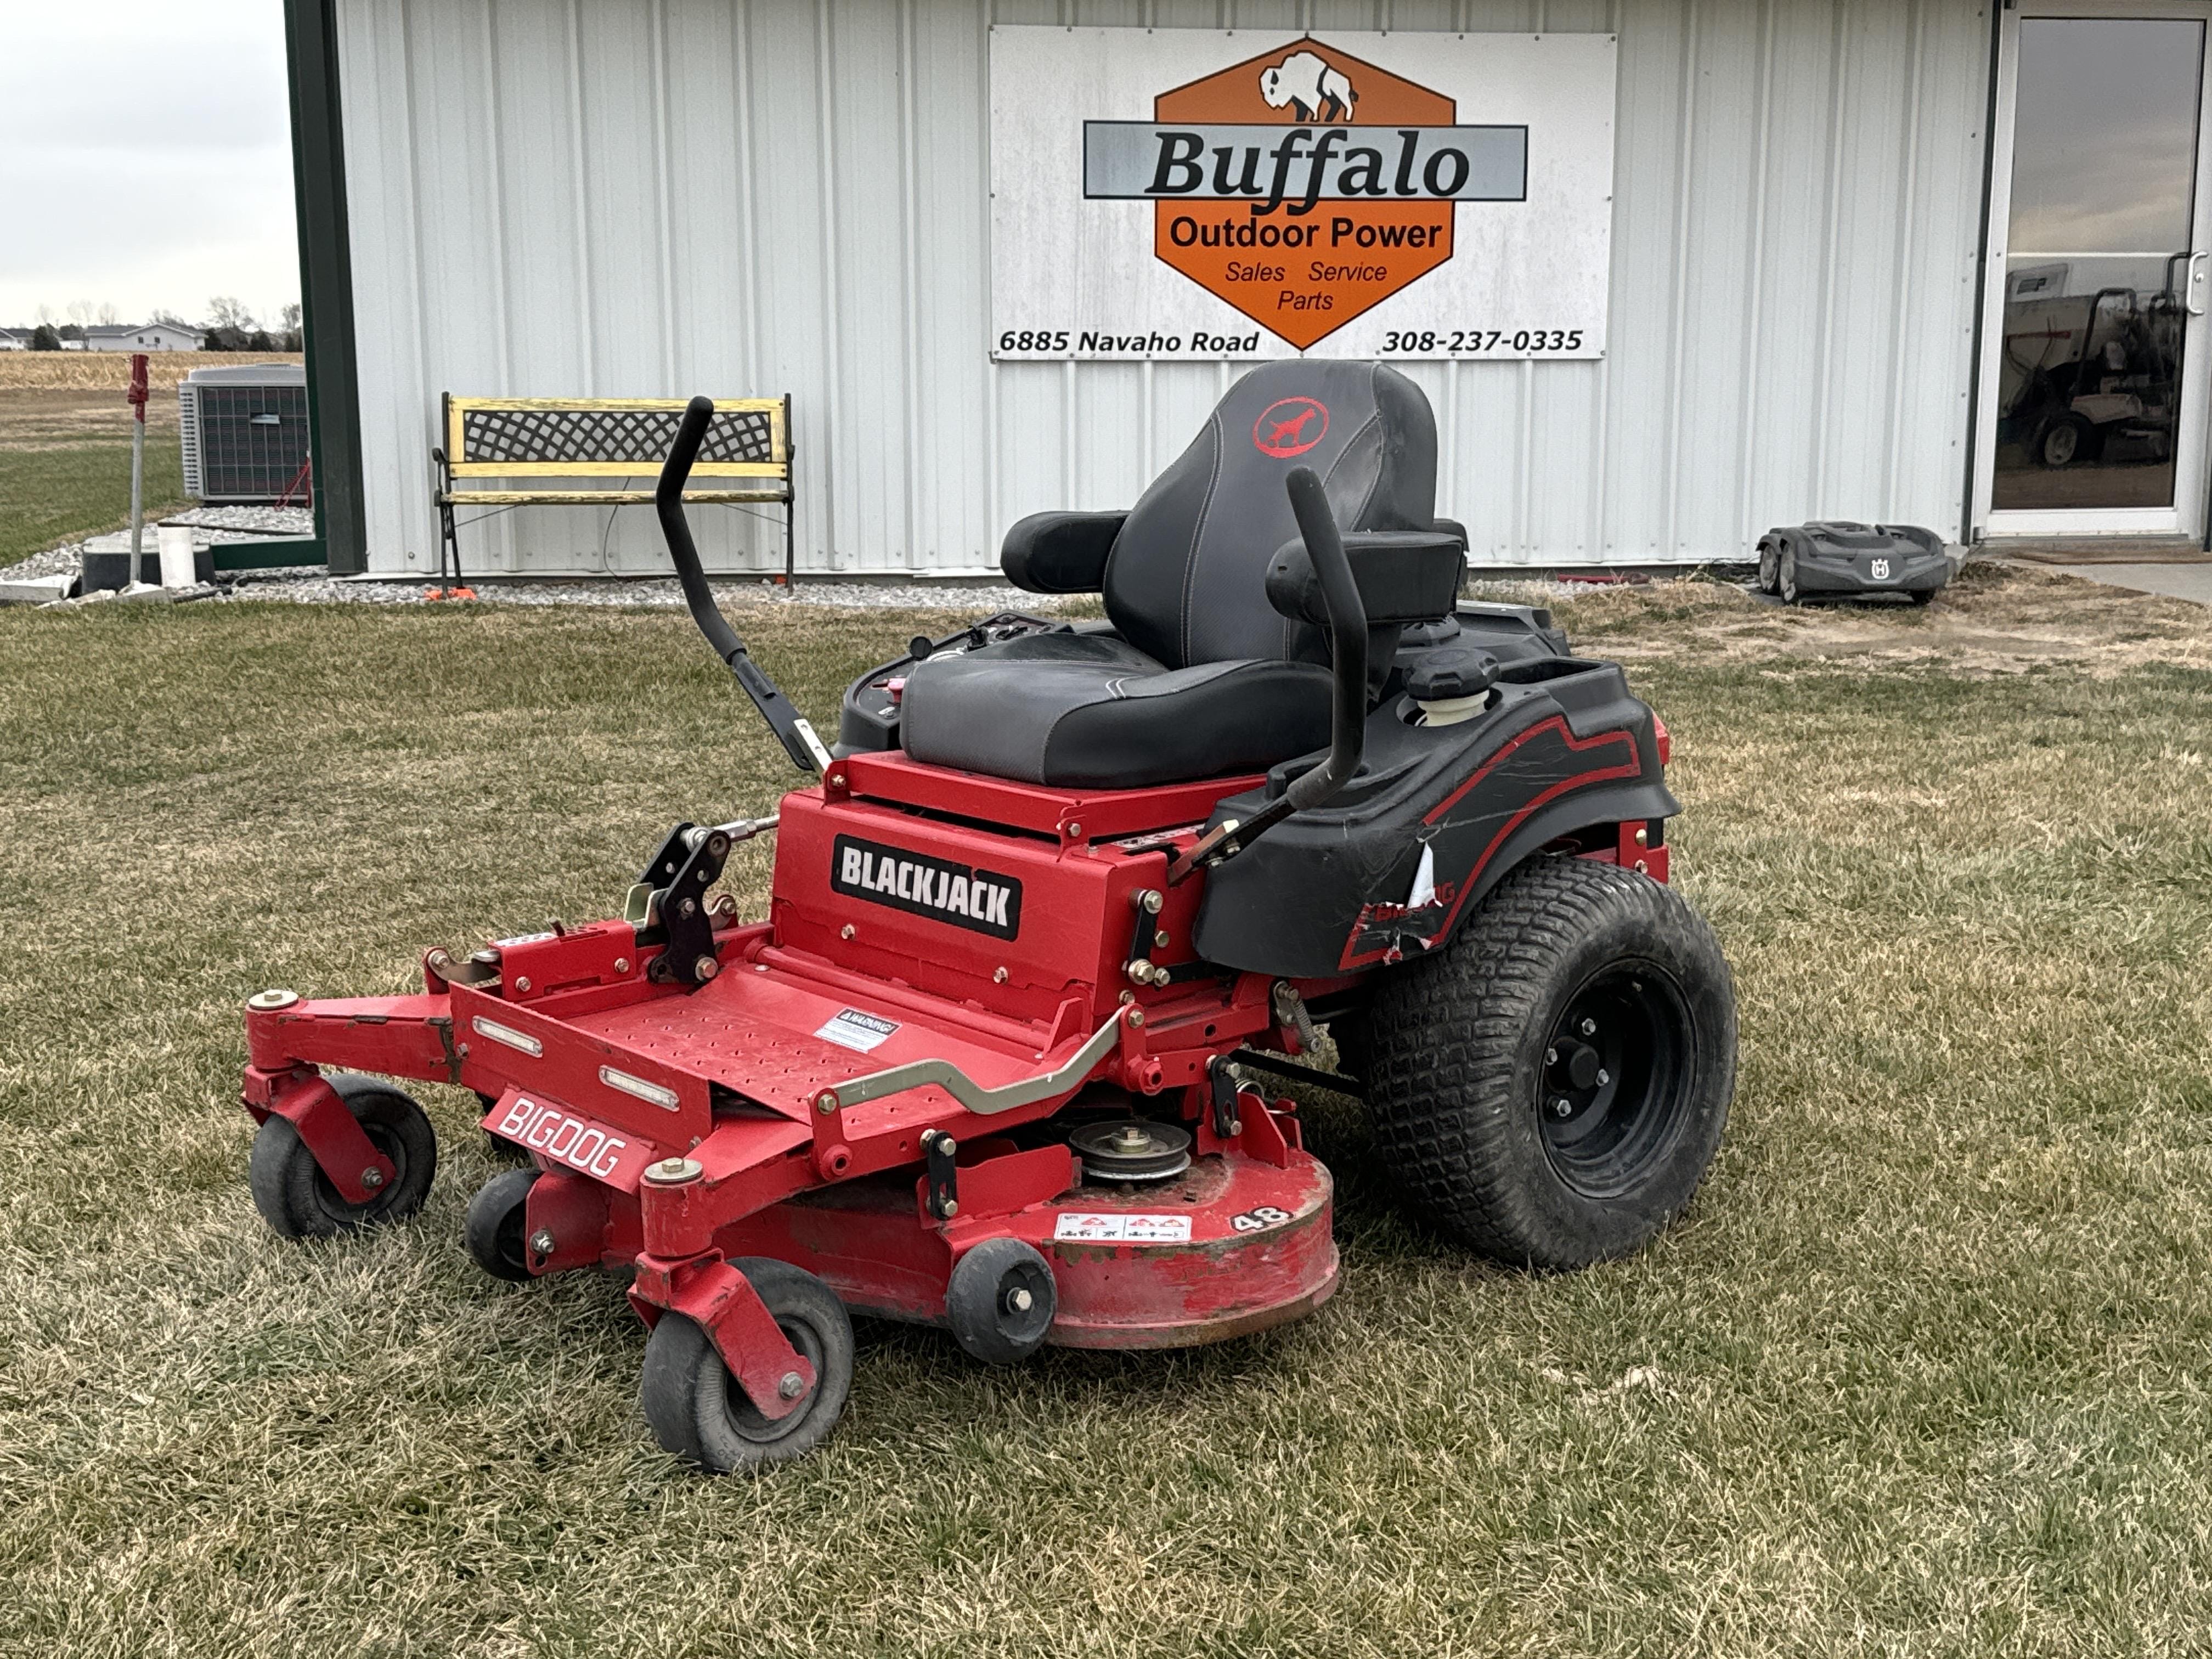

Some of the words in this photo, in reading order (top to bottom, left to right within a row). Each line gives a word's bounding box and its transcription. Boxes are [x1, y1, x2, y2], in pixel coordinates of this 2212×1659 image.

[1144, 128, 1469, 216] Buffalo
[1170, 216, 1321, 247] Outdoor
[1331, 218, 1443, 248] Power
[1225, 261, 1285, 282] Sales
[1308, 261, 1388, 282] Service
[1277, 290, 1334, 311] Parts
[1000, 330, 1070, 352] 6885
[1078, 331, 1182, 352] Navaho
[1190, 331, 1260, 352] Road
[1382, 330, 1584, 352] 308-237-0335
[840, 846, 1011, 927] BLACKJACK
[498, 1098, 627, 1177] BIGDOG
[1233, 1206, 1289, 1231] 48
